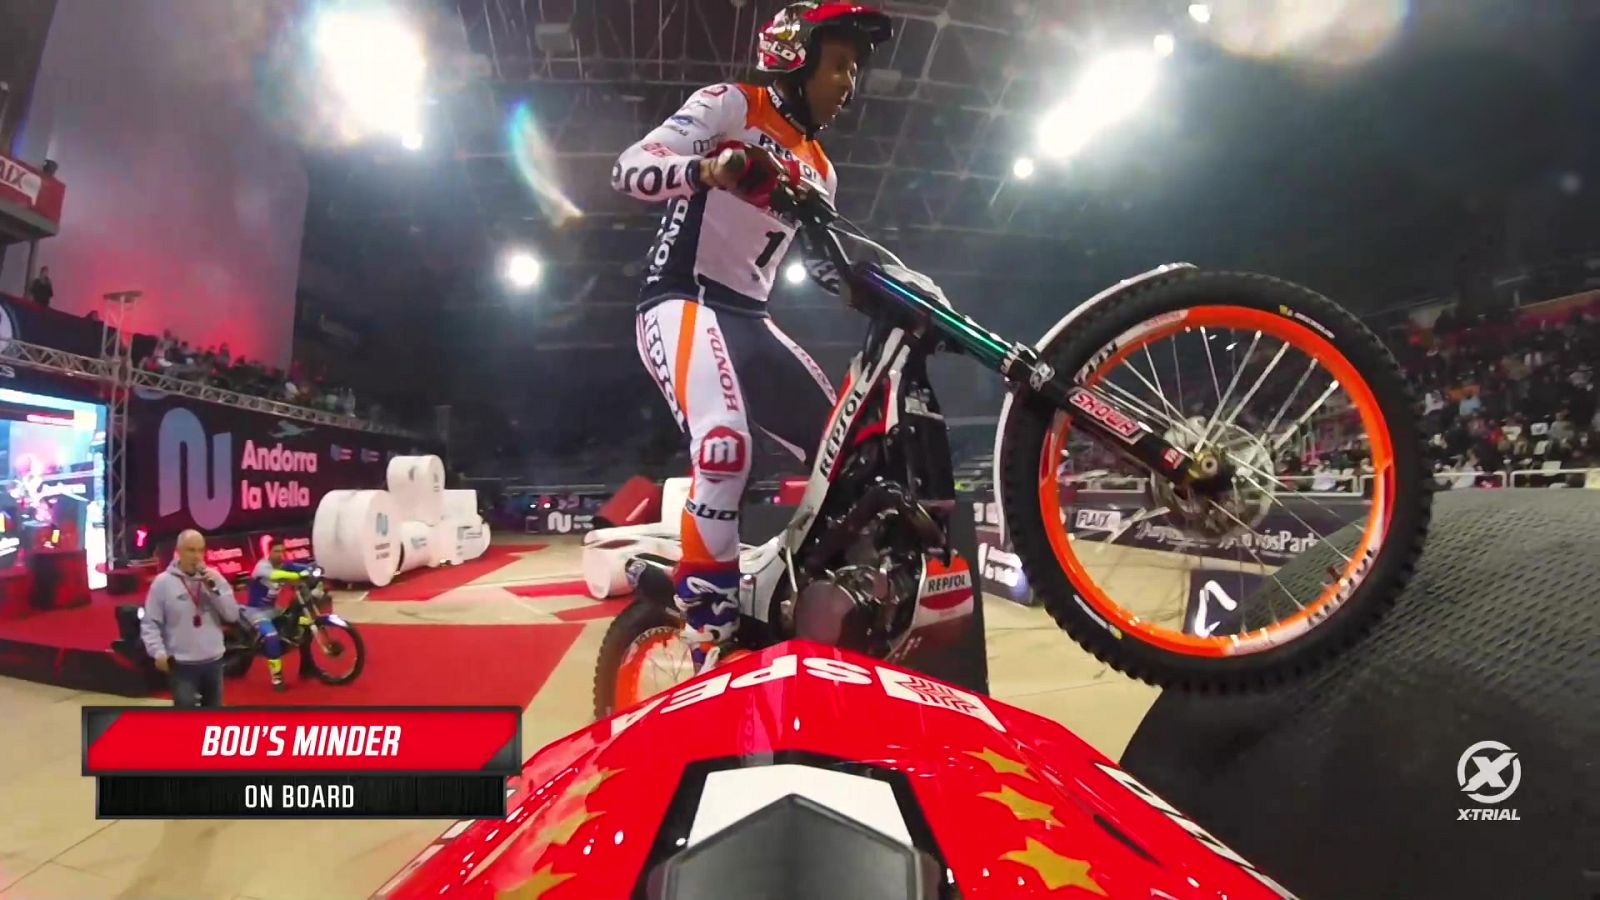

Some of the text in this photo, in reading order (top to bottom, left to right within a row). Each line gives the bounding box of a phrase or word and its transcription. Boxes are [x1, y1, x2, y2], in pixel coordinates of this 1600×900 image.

[755, 231, 787, 268] 1
[707, 327, 740, 412] HONDA
[819, 389, 866, 478] REPSOL
[1076, 391, 1138, 436] SHOWA
[241, 439, 318, 473] Andorra
[242, 479, 310, 510] la Vella
